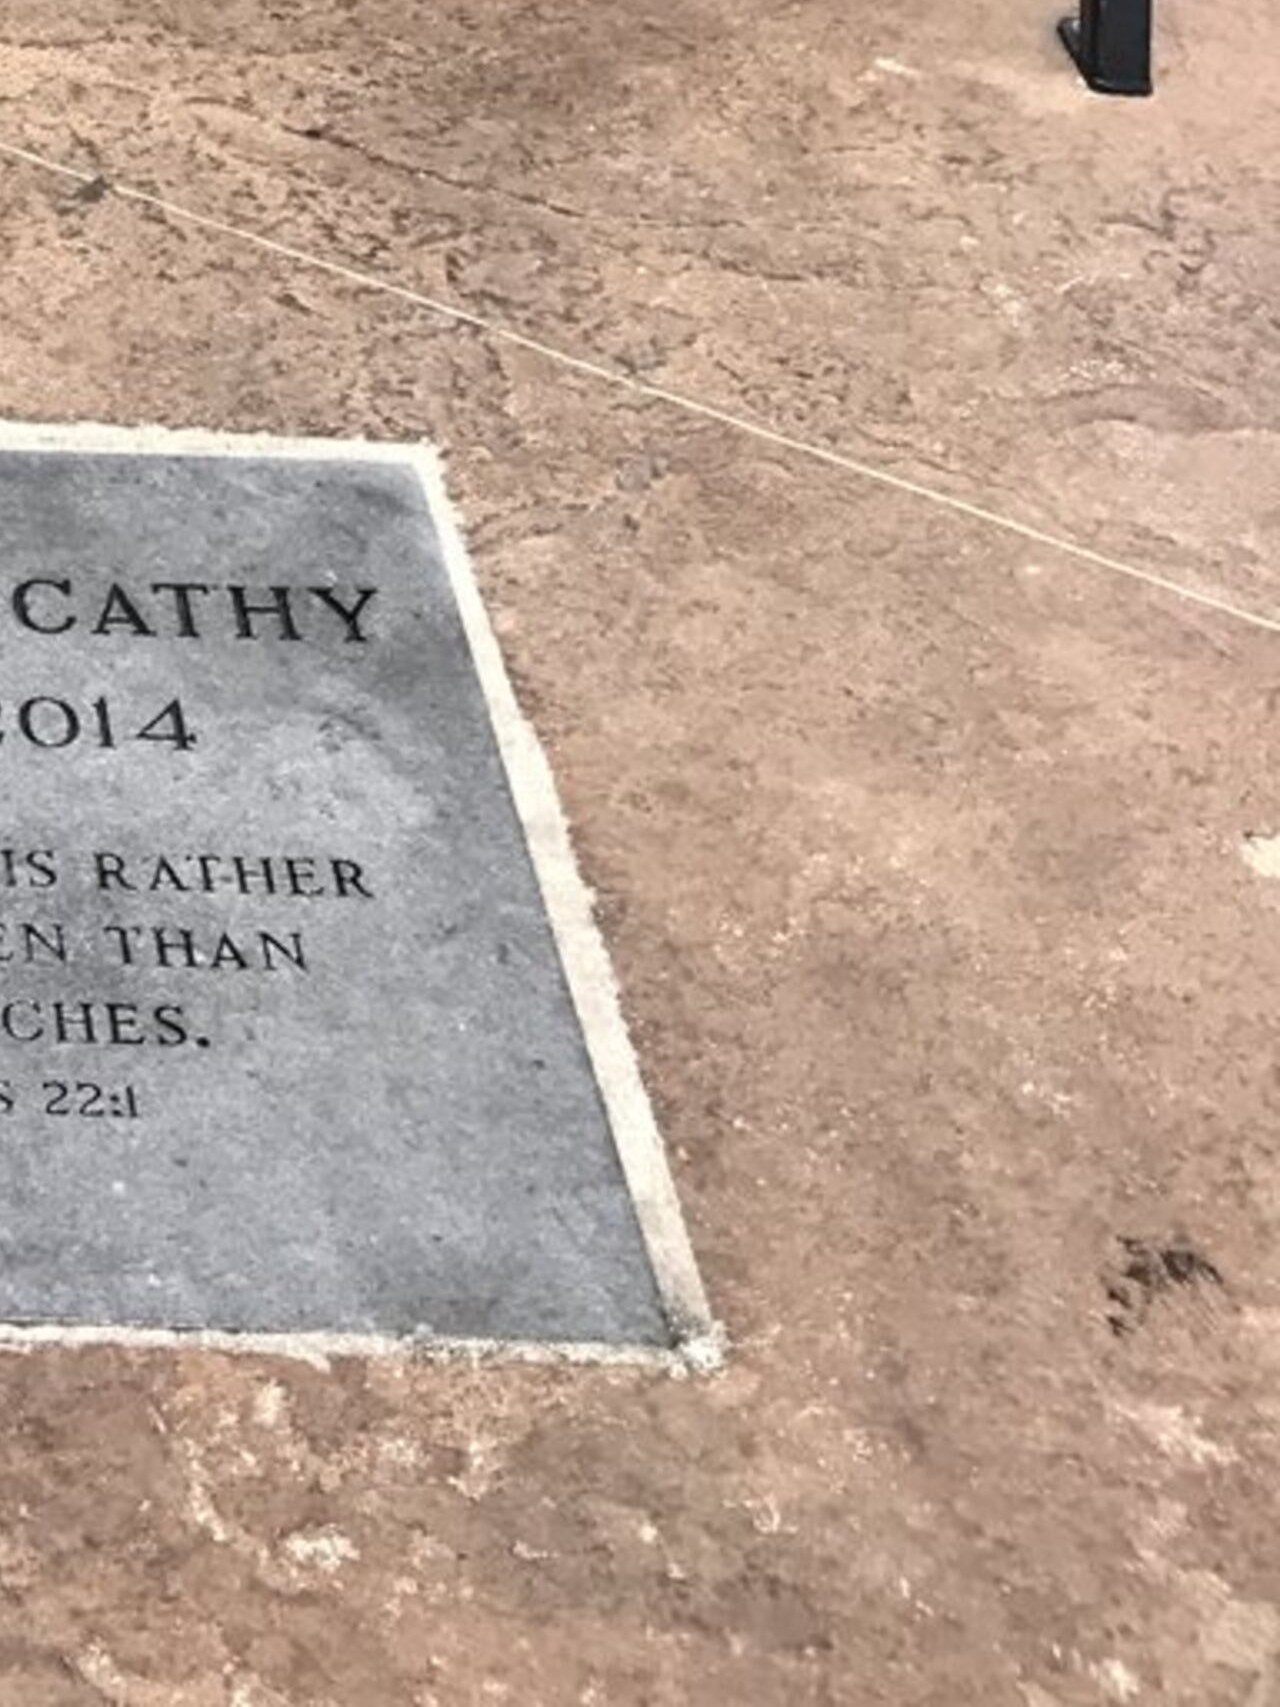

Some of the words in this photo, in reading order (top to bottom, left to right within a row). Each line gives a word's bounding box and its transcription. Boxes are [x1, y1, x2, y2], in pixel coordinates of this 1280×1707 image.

[11, 578, 378, 644] CATHY
[0, 848, 58, 888] IS
[94, 851, 375, 899] RATHER
[104, 922, 308, 972] THAN
[42, 1080, 140, 1118] 22:1
